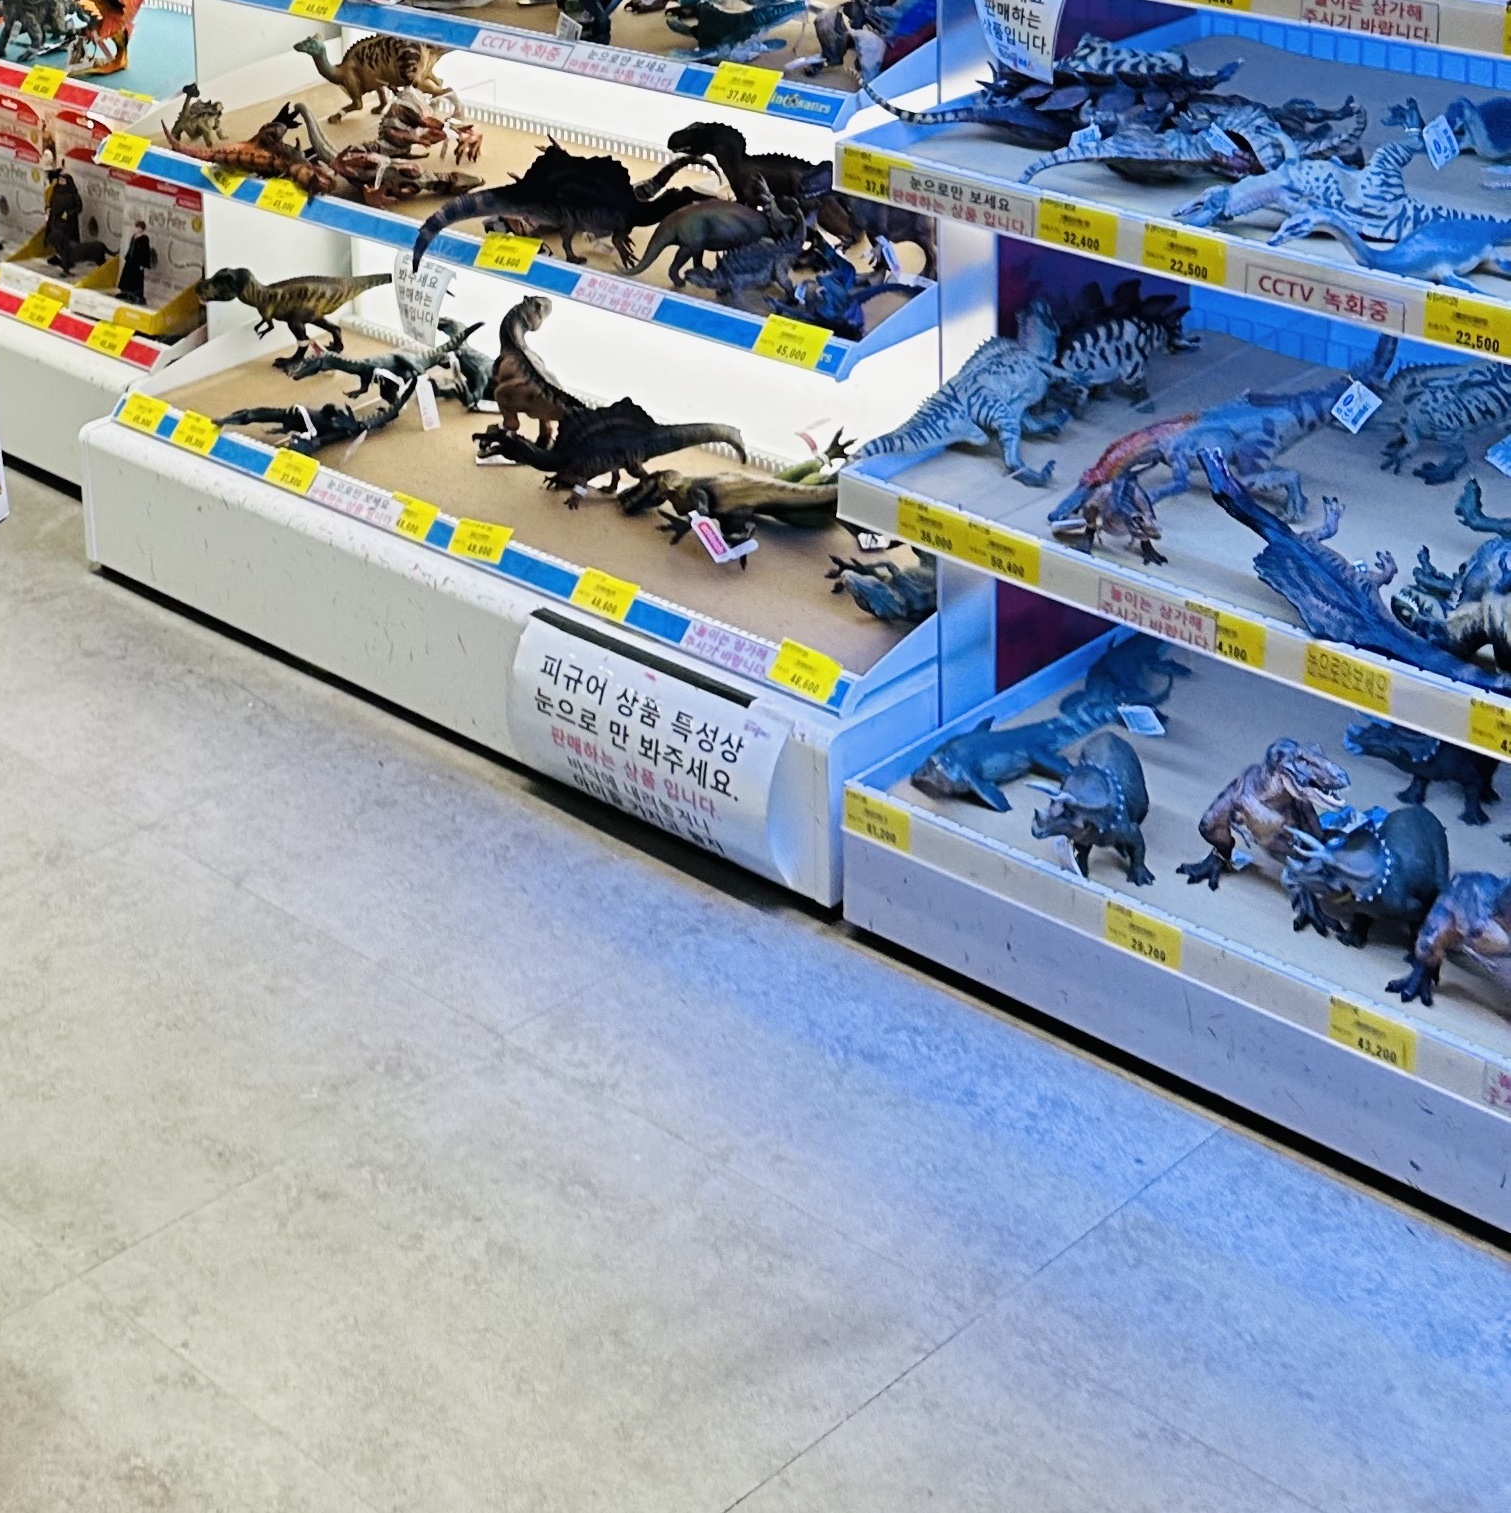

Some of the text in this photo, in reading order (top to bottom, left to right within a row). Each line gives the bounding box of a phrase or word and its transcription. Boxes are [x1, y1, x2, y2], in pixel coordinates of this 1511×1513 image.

[982, 0, 1043, 29] 판매하는
[480, 35, 562, 62] CCTV 녹화중
[587, 49, 667, 74] 눈으로만 보세요
[891, 190, 944, 215] 판매하는
[951, 205, 977, 223] 상품
[909, 176, 1010, 211] 눈으로만 보세요
[1063, 231, 1100, 251] 32,400
[1169, 259, 1208, 279] 22,500
[1258, 276, 1388, 323] CCTV 녹화중
[1455, 330, 1500, 353] 22,500
[1109, 583, 1203, 632] 놀이는 삼가해
[539, 654, 745, 764] 피규어 상품 특성상
[534, 686, 739, 802] 눈으로 만 봐주세요.
[550, 724, 616, 769] 판매하는
[624, 758, 657, 791] 상품
